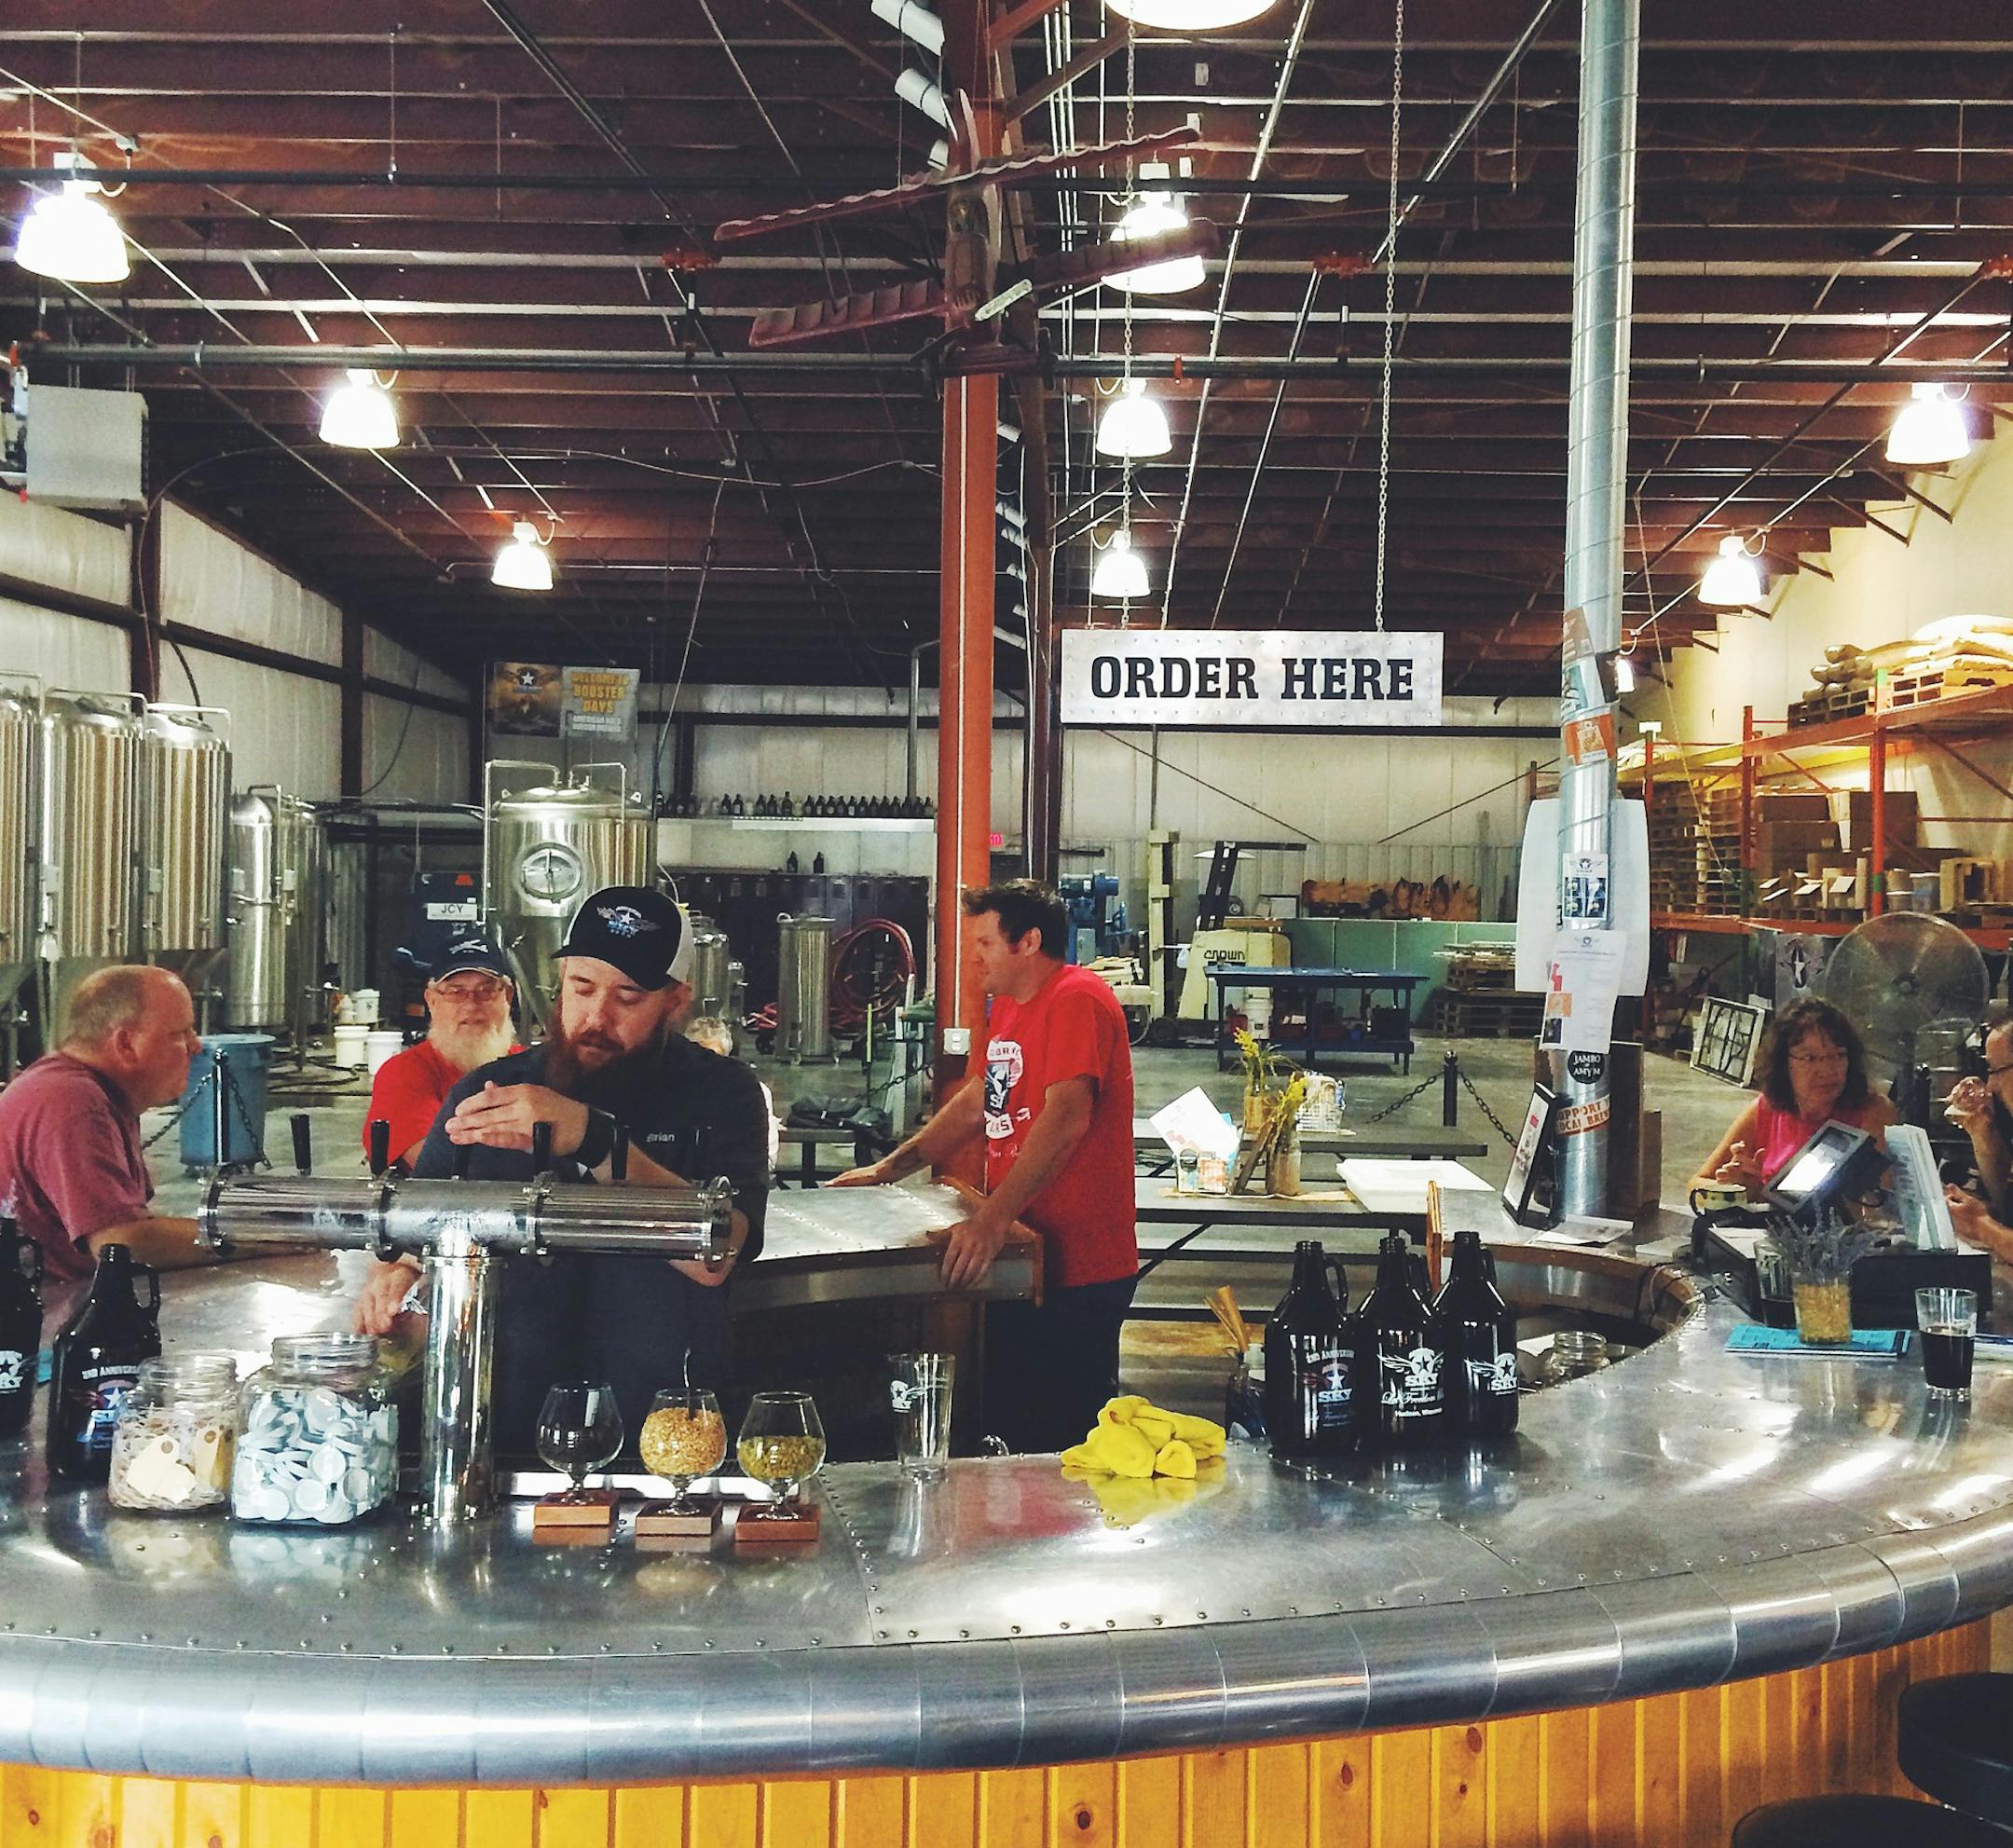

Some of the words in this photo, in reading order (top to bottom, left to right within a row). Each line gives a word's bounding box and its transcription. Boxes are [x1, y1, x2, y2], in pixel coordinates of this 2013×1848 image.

[1091, 655, 1258, 699] ORDER
[1280, 657, 1413, 701] HERE
[573, 684, 626, 700] BOOSTER
[582, 700, 614, 714] DAYS
[441, 904, 464, 914] JCY
[1573, 1054, 1601, 1065] JAMBO
[1404, 1373, 1438, 1387] SKY
[1490, 1376, 1518, 1391] SKY
[1318, 1388, 1353, 1403] SKY
